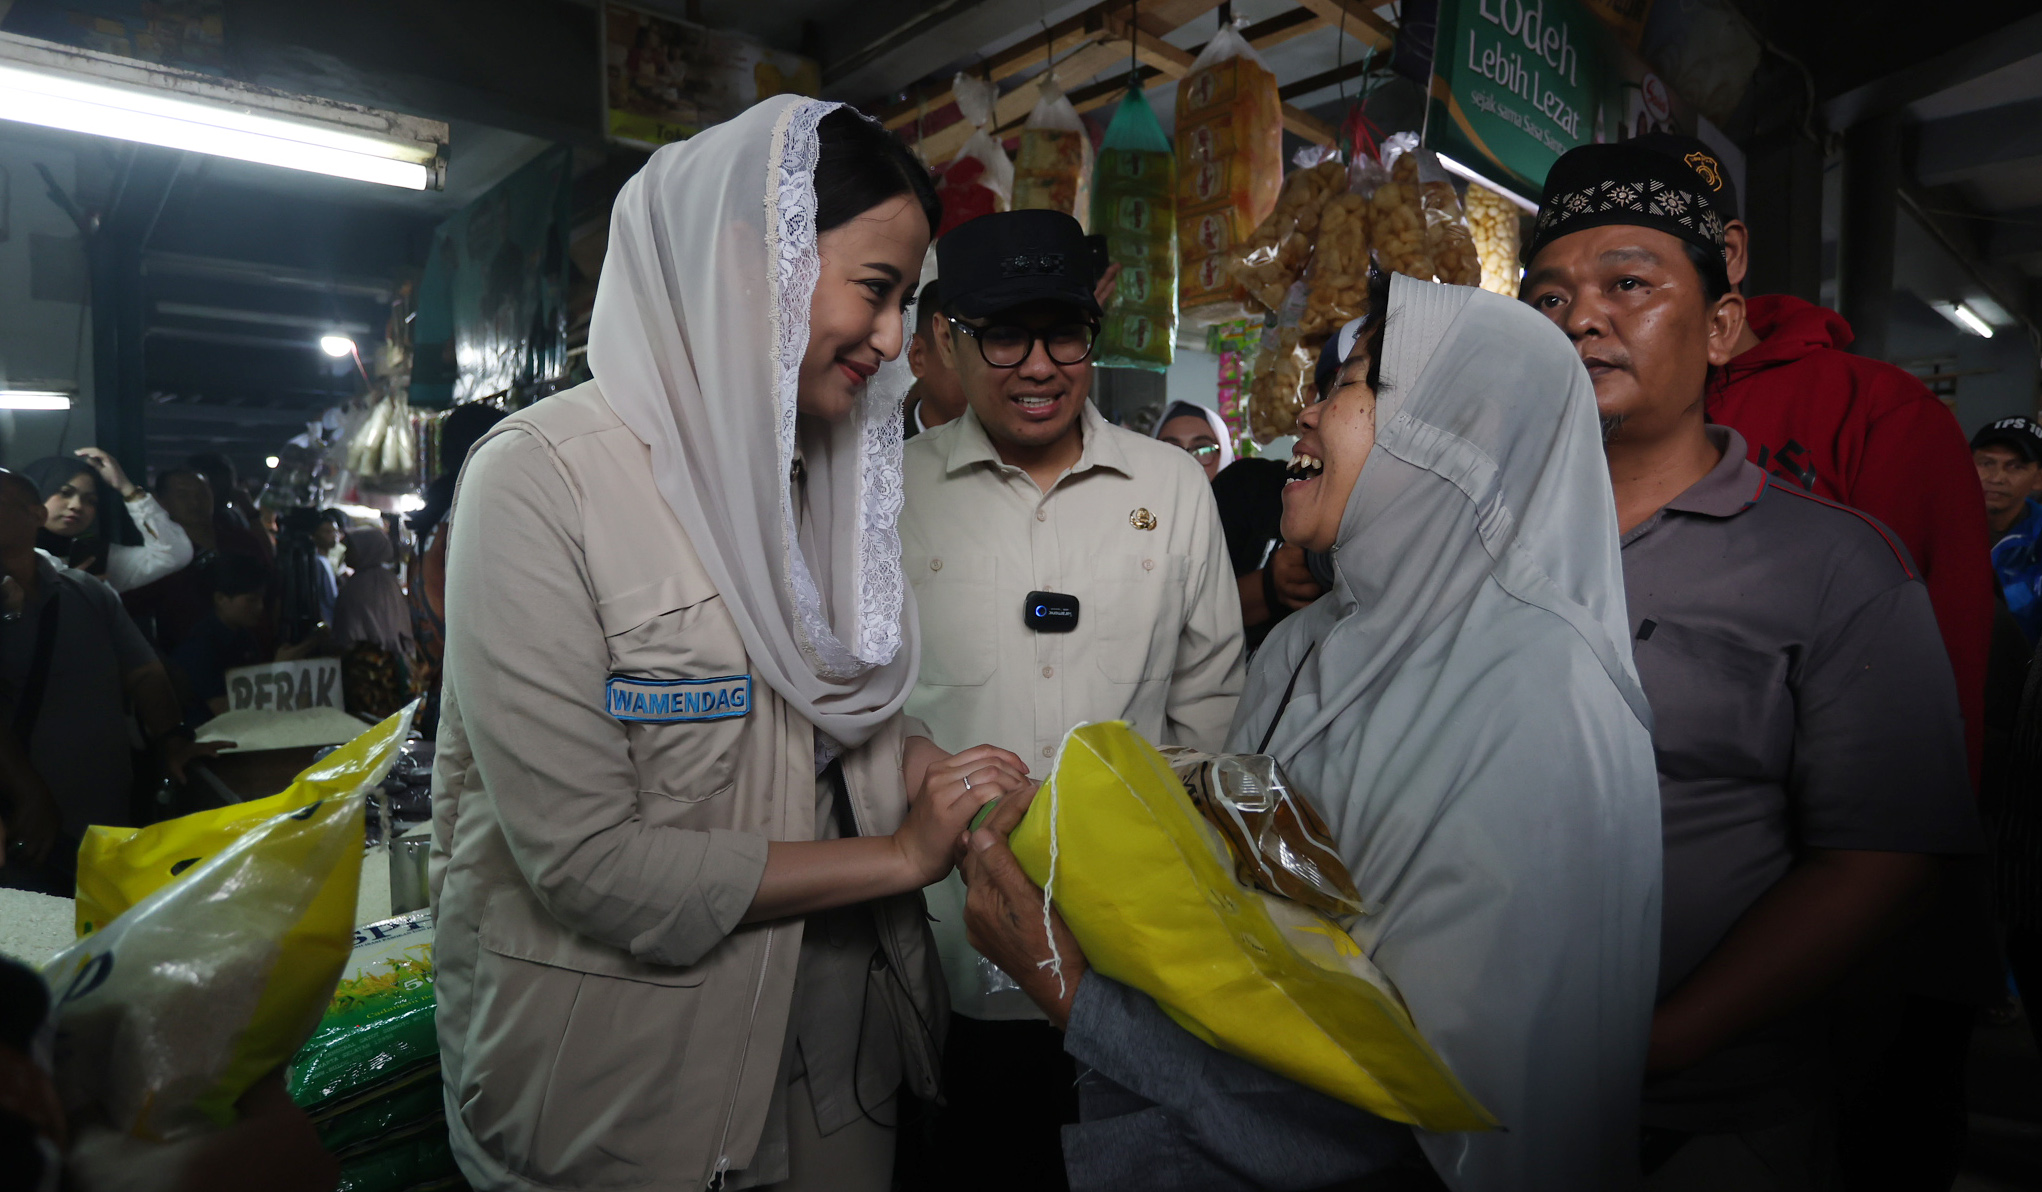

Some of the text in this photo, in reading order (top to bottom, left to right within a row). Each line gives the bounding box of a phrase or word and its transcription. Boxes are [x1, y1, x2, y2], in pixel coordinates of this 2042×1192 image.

[1468, 28, 1579, 140] Lebih Lezat
[1471, 90, 1497, 112] sejak
[1498, 103, 1523, 128] sama
[656, 124, 694, 142] Tok
[1994, 418, 2026, 430] TPS
[613, 687, 745, 714] WAMENDAG
[312, 1055, 339, 1070] AKARTA
